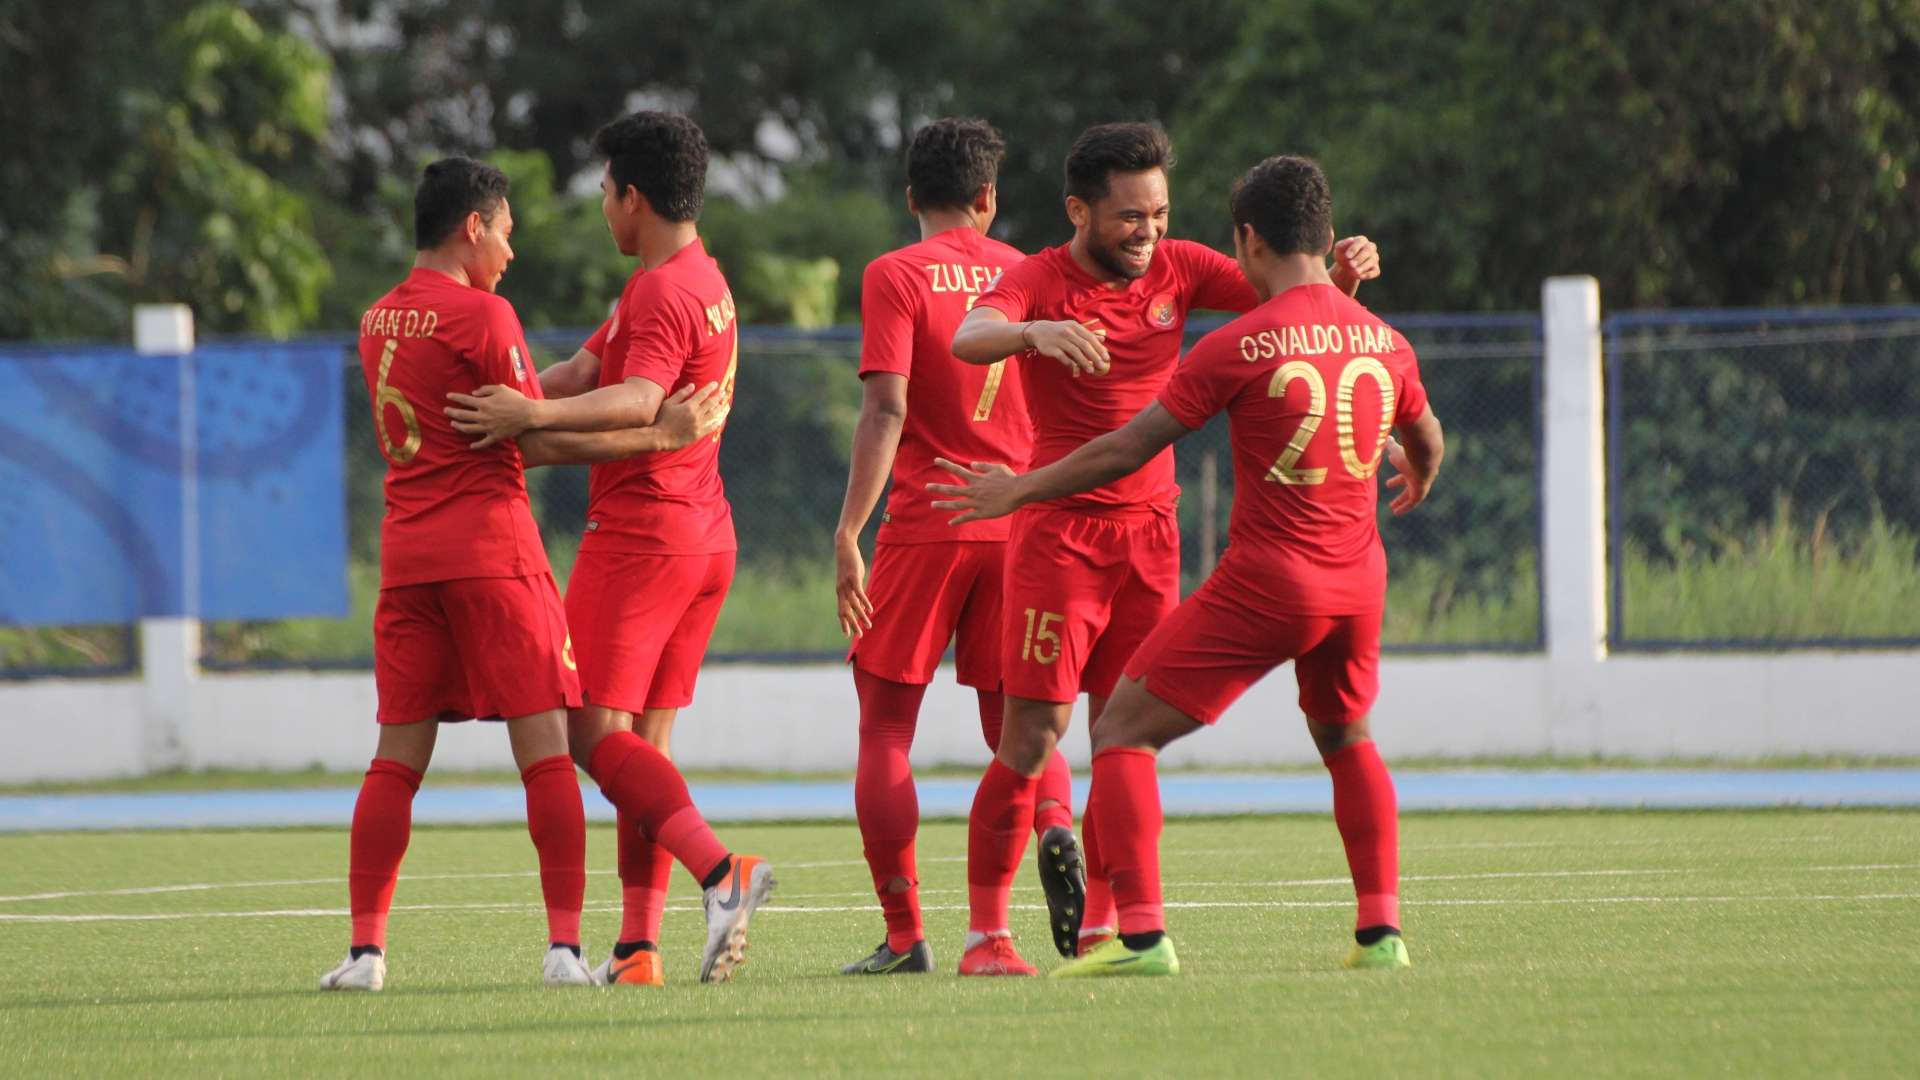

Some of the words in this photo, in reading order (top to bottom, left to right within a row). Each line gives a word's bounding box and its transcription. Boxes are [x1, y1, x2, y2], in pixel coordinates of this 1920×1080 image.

[1240, 324, 1343, 362] OSVALDO
[376, 338, 421, 463] 6
[1264, 356, 1395, 485] 20
[1022, 608, 1065, 665] 15
